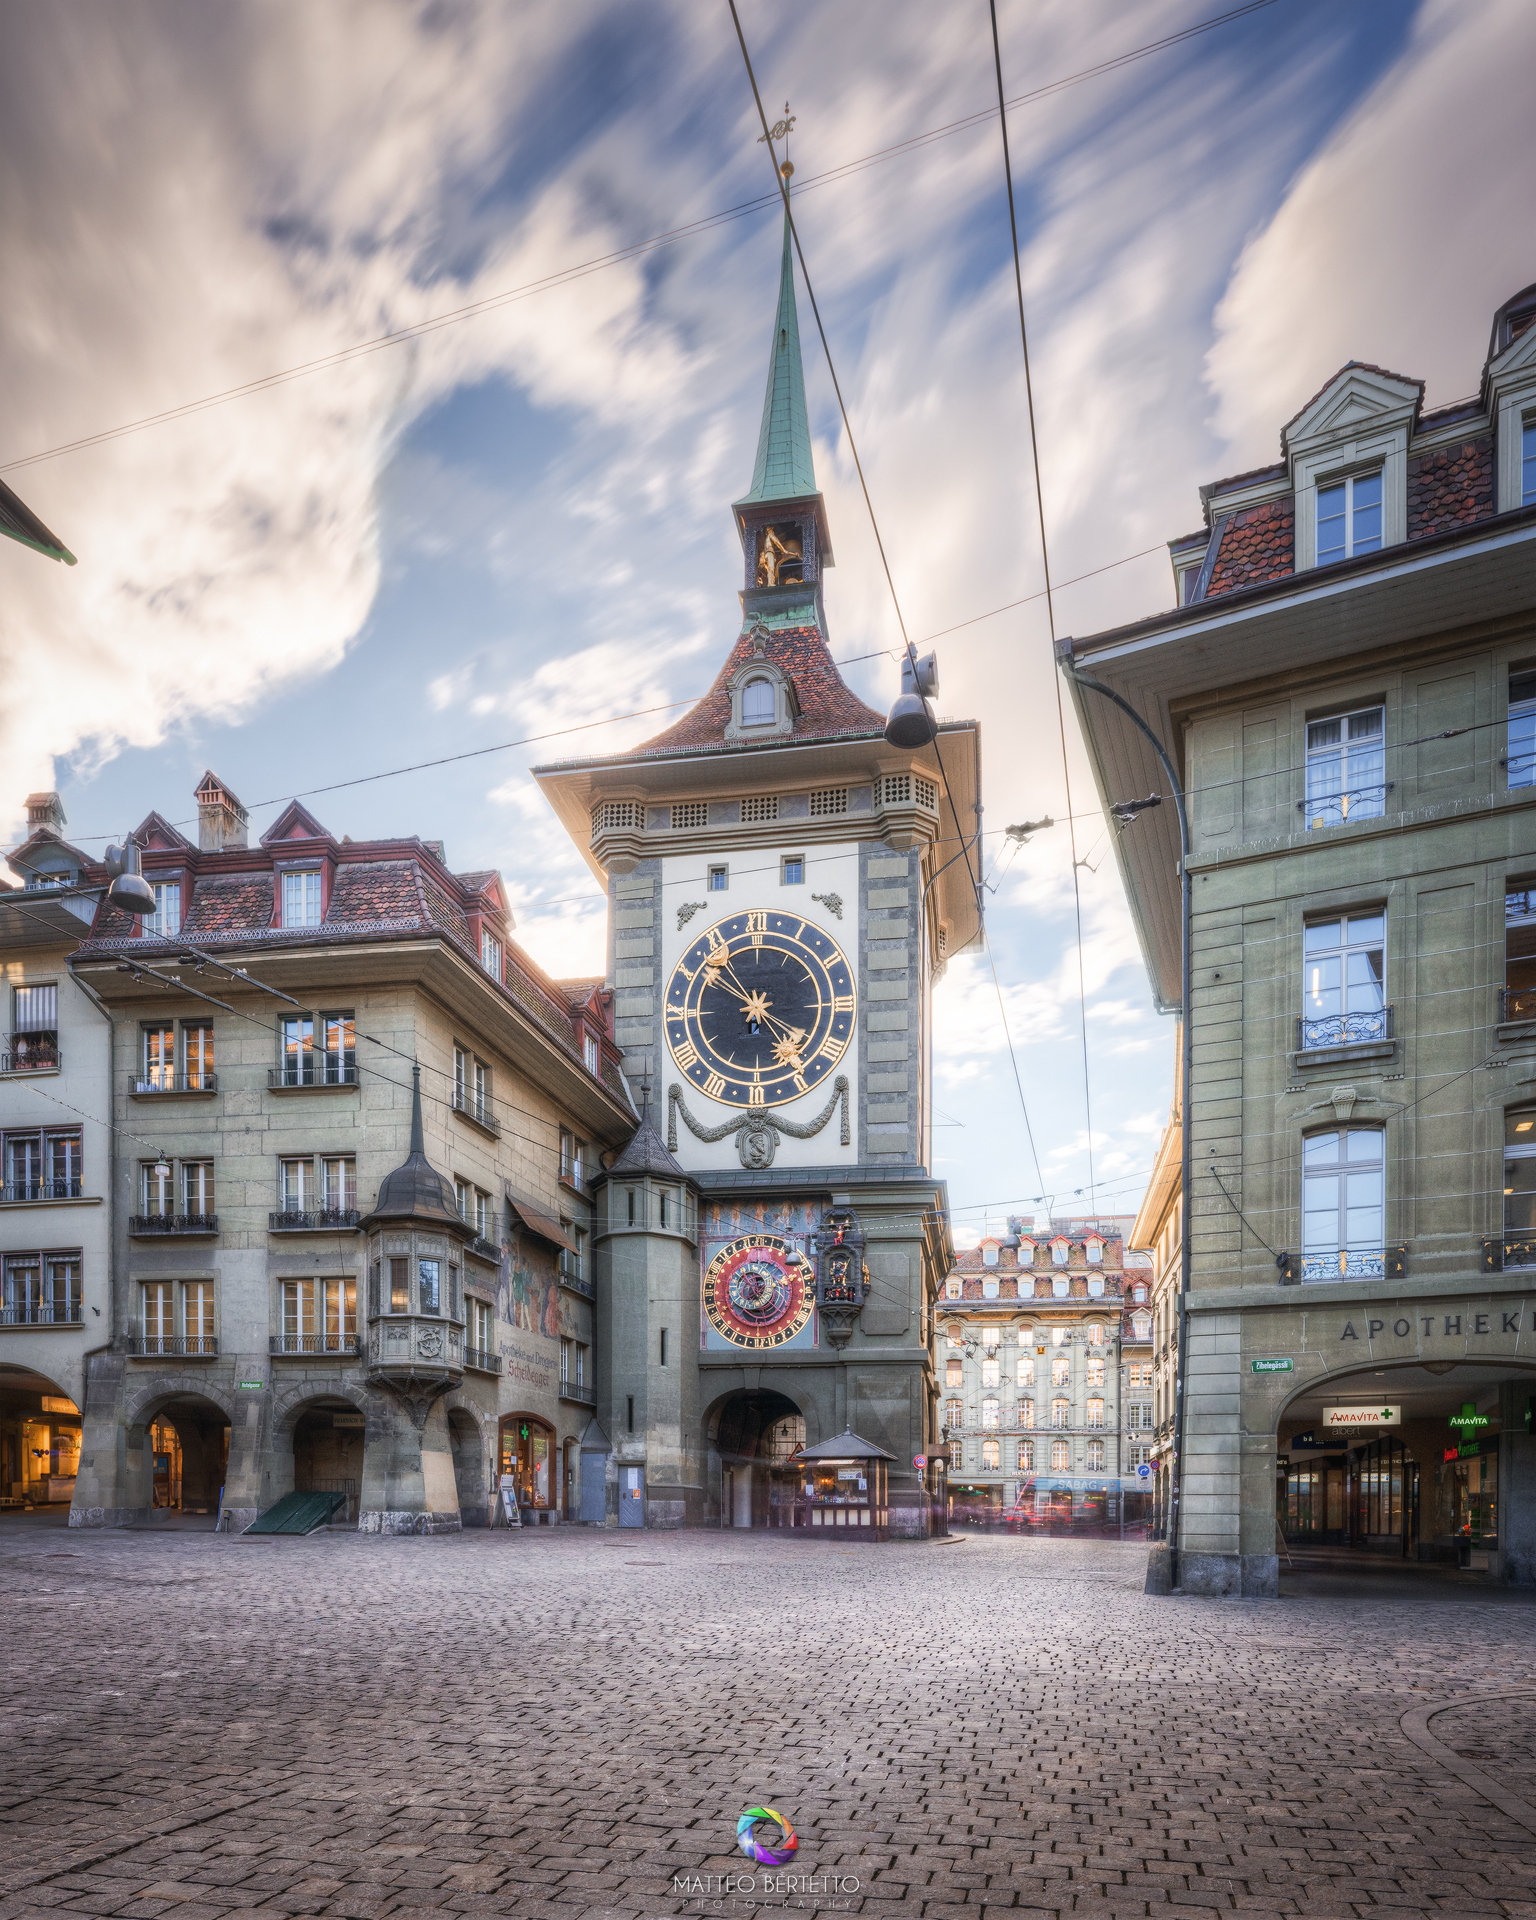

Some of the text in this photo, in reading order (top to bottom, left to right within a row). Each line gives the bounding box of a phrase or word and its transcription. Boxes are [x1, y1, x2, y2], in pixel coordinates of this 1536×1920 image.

[1340, 1311, 1536, 1341] APOTHEK
[1256, 1360, 1288, 1371] Zibelegässli
[508, 1360, 549, 1388] Scheidegger
[1330, 1412, 1380, 1424] AMAVITA
[1449, 1416, 1488, 1427] AMAVITA
[1058, 1480, 1097, 1490] SABAG
